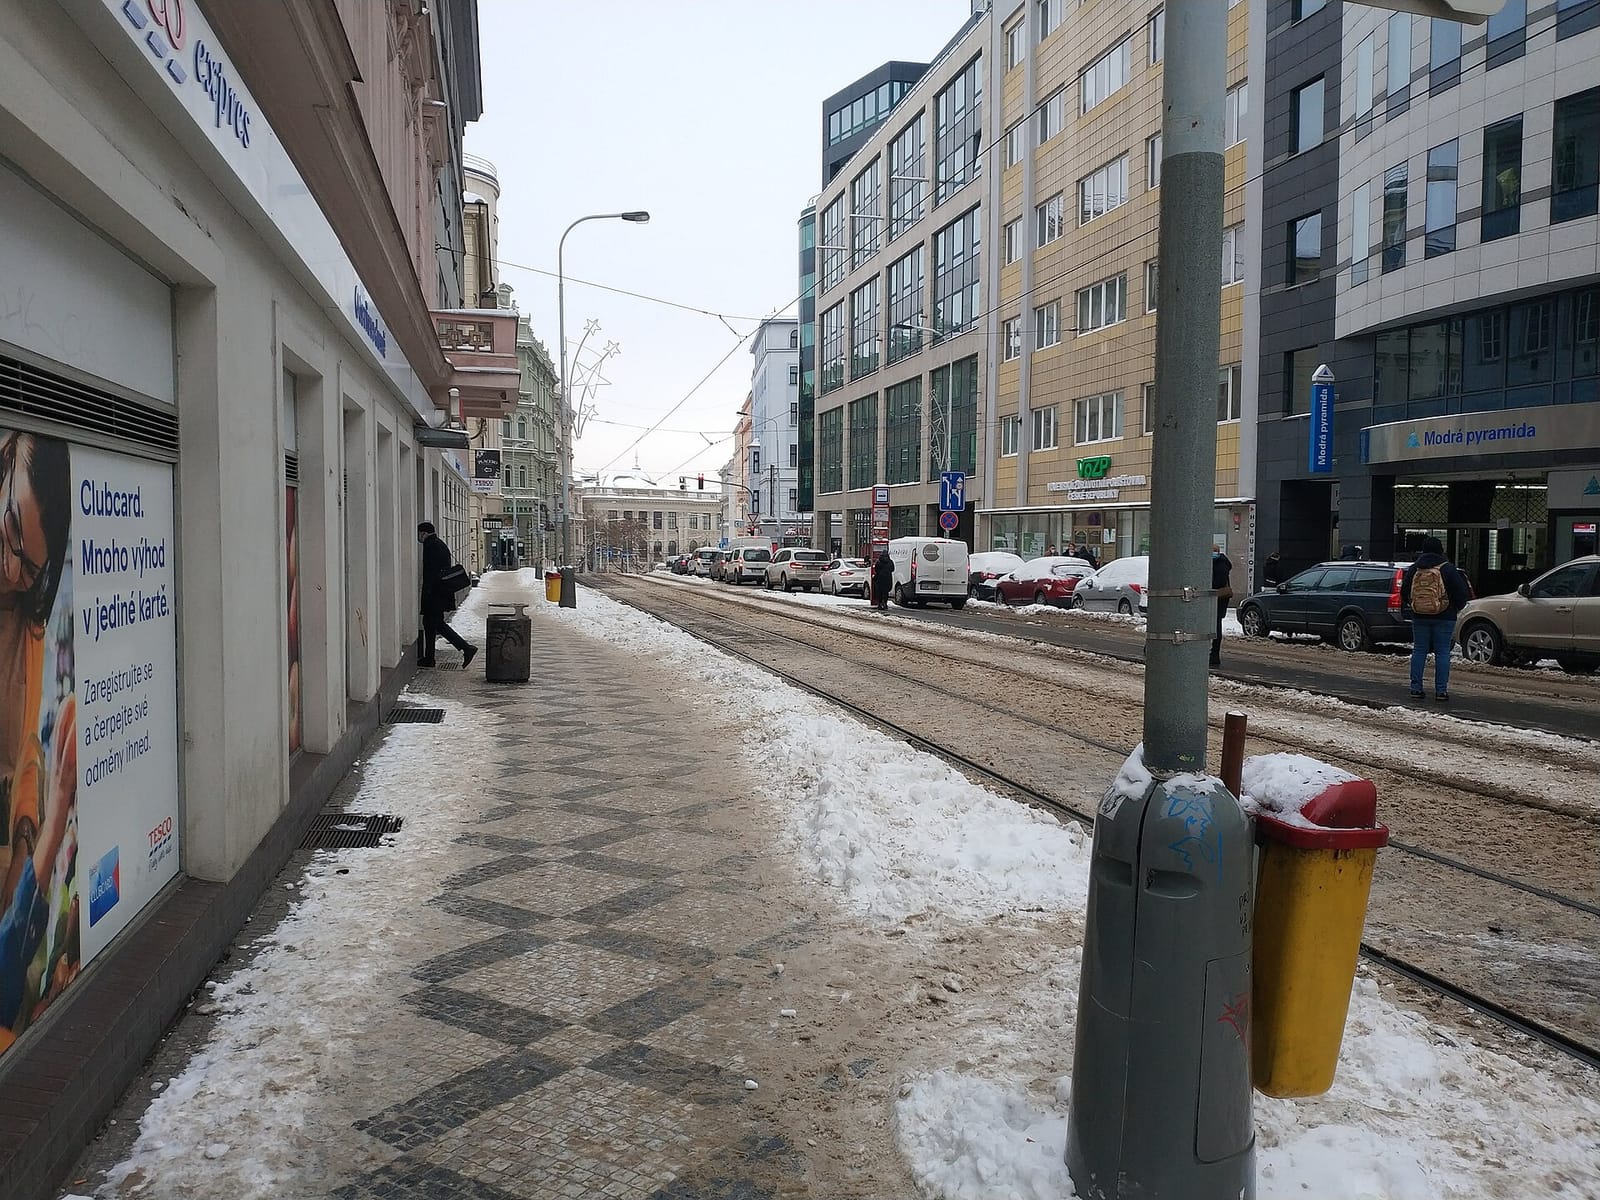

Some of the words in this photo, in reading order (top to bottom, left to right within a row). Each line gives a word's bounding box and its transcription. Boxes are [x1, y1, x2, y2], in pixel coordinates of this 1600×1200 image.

[195, 40, 250, 148] expres
[1320, 388, 1329, 433] pyramida
[1317, 434, 1327, 465] Modrá
[1424, 429, 1463, 446] Modrá
[1466, 422, 1536, 445] pyramida
[80, 478, 144, 518] Clubcard.
[82, 537, 129, 576] Mnoho
[131, 537, 165, 578] výhod
[83, 607, 91, 635] v
[95, 590, 136, 642] jediné
[138, 584, 170, 622] kartě.
[84, 670, 143, 705] Zaregistrujte
[143, 662, 153, 680] se
[85, 726, 91, 746] a
[93, 709, 133, 742] čerpejte
[134, 694, 149, 720] své
[85, 748, 124, 787] odměny
[125, 732, 151, 764] ihned.
[147, 816, 172, 848] TESCO
